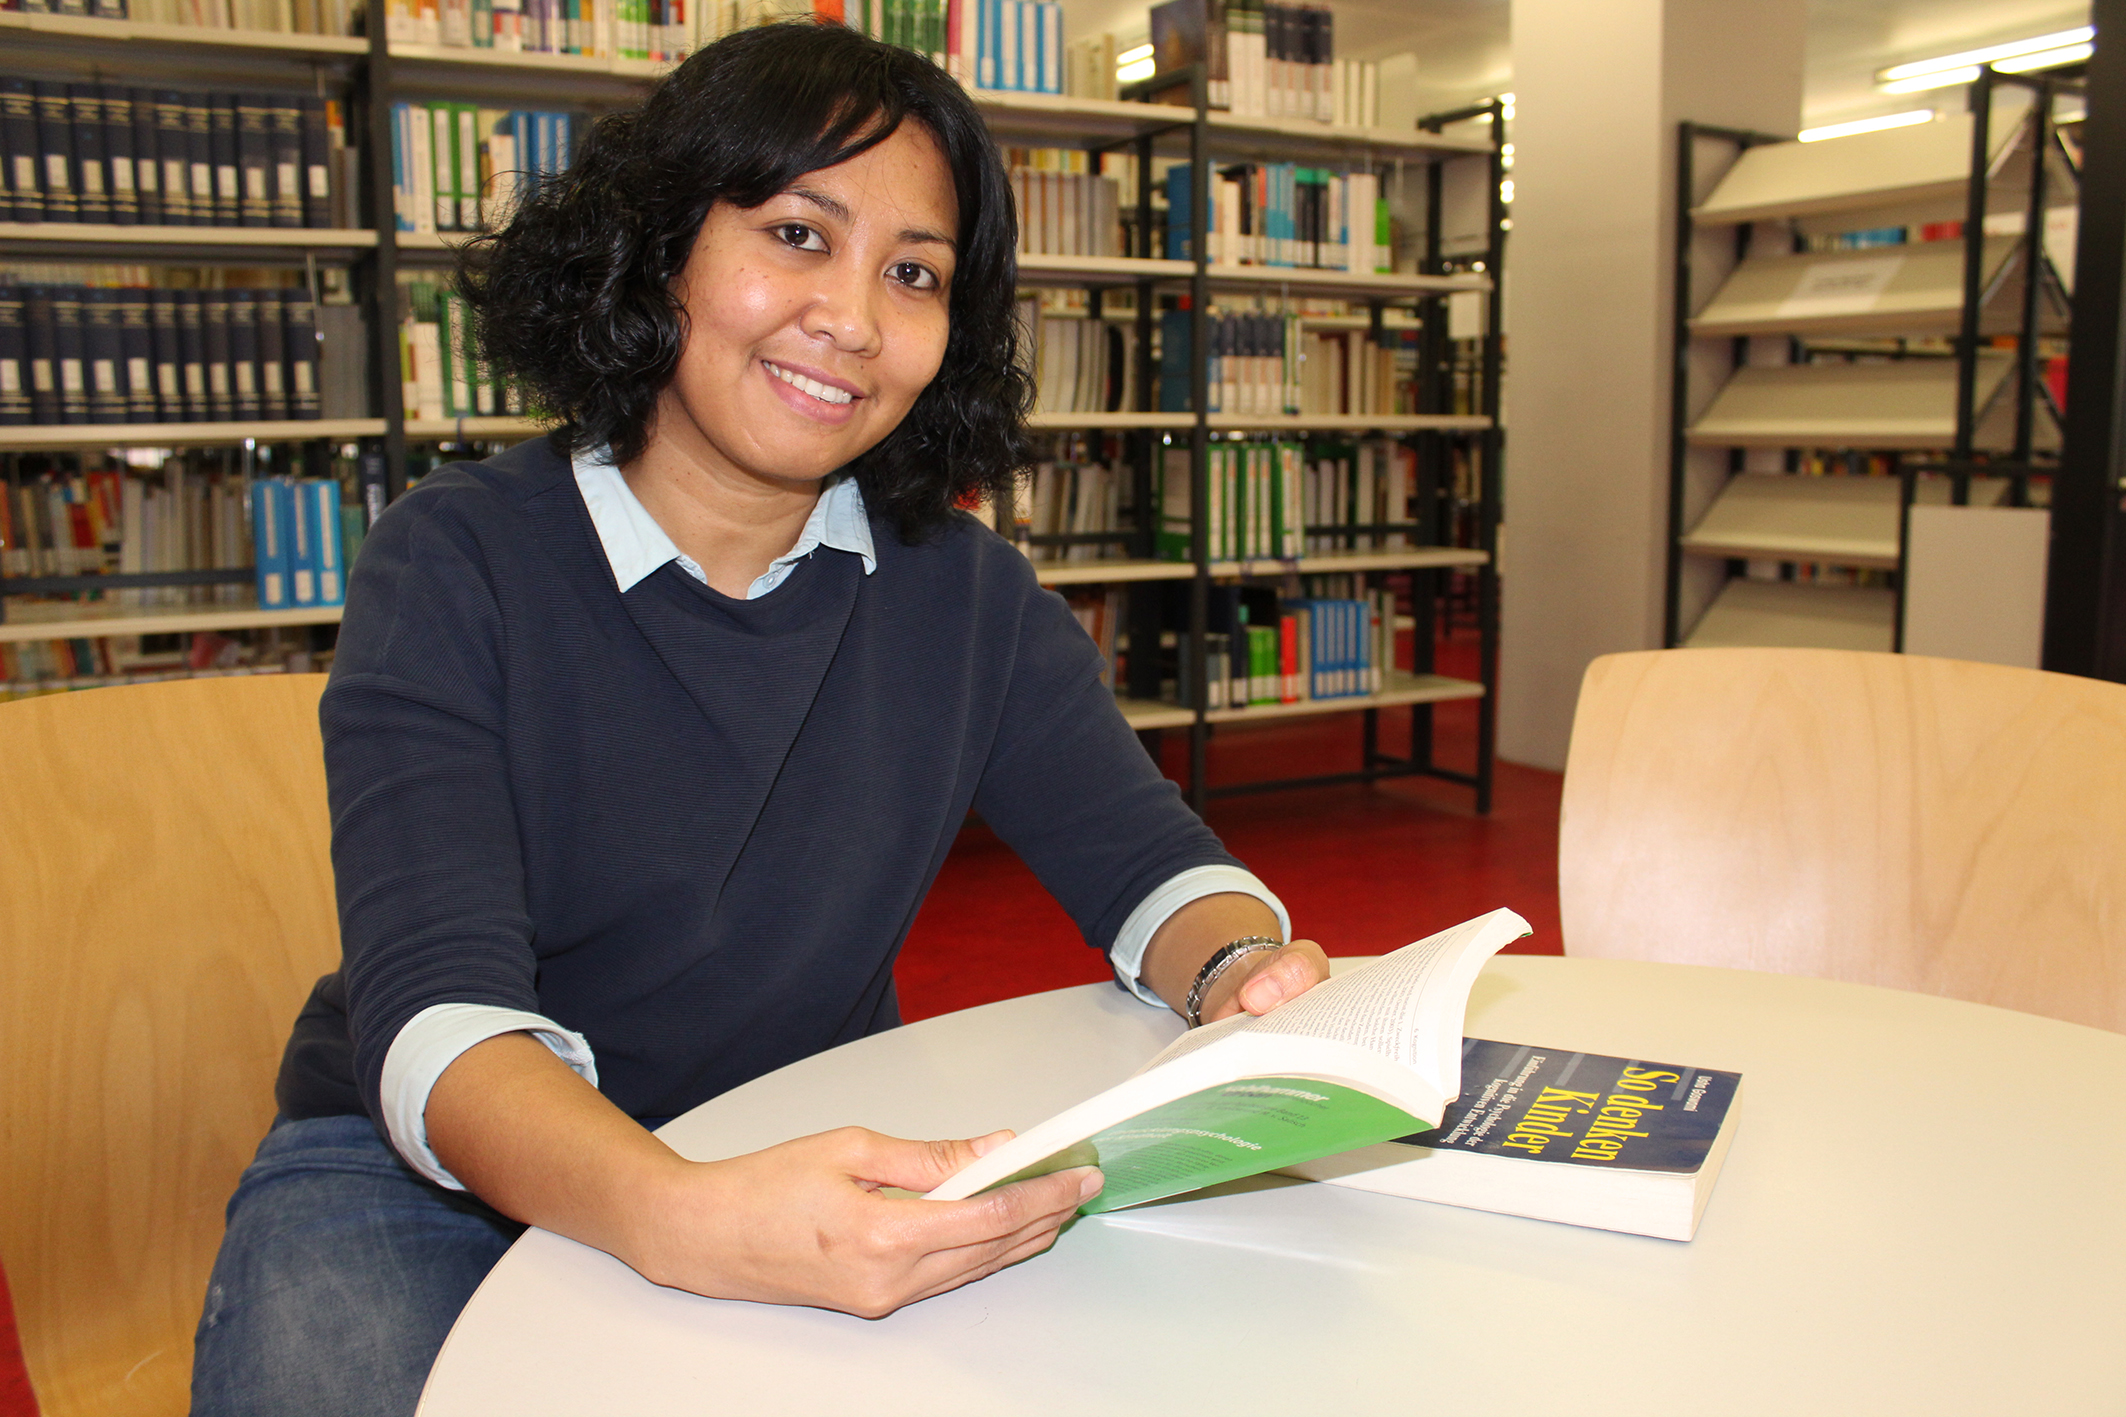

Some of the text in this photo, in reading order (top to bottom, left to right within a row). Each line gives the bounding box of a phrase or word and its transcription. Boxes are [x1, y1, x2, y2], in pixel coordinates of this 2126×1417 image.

[1440, 1078, 1508, 1144] kognitiven Entwicklung
[1465, 1055, 1546, 1147] Einführung in die Psychologie der
[1502, 1086, 1600, 1154] Kinder
[1570, 1066, 1681, 1161] So denken
[1683, 1075, 1713, 1112] Usha Goswami
